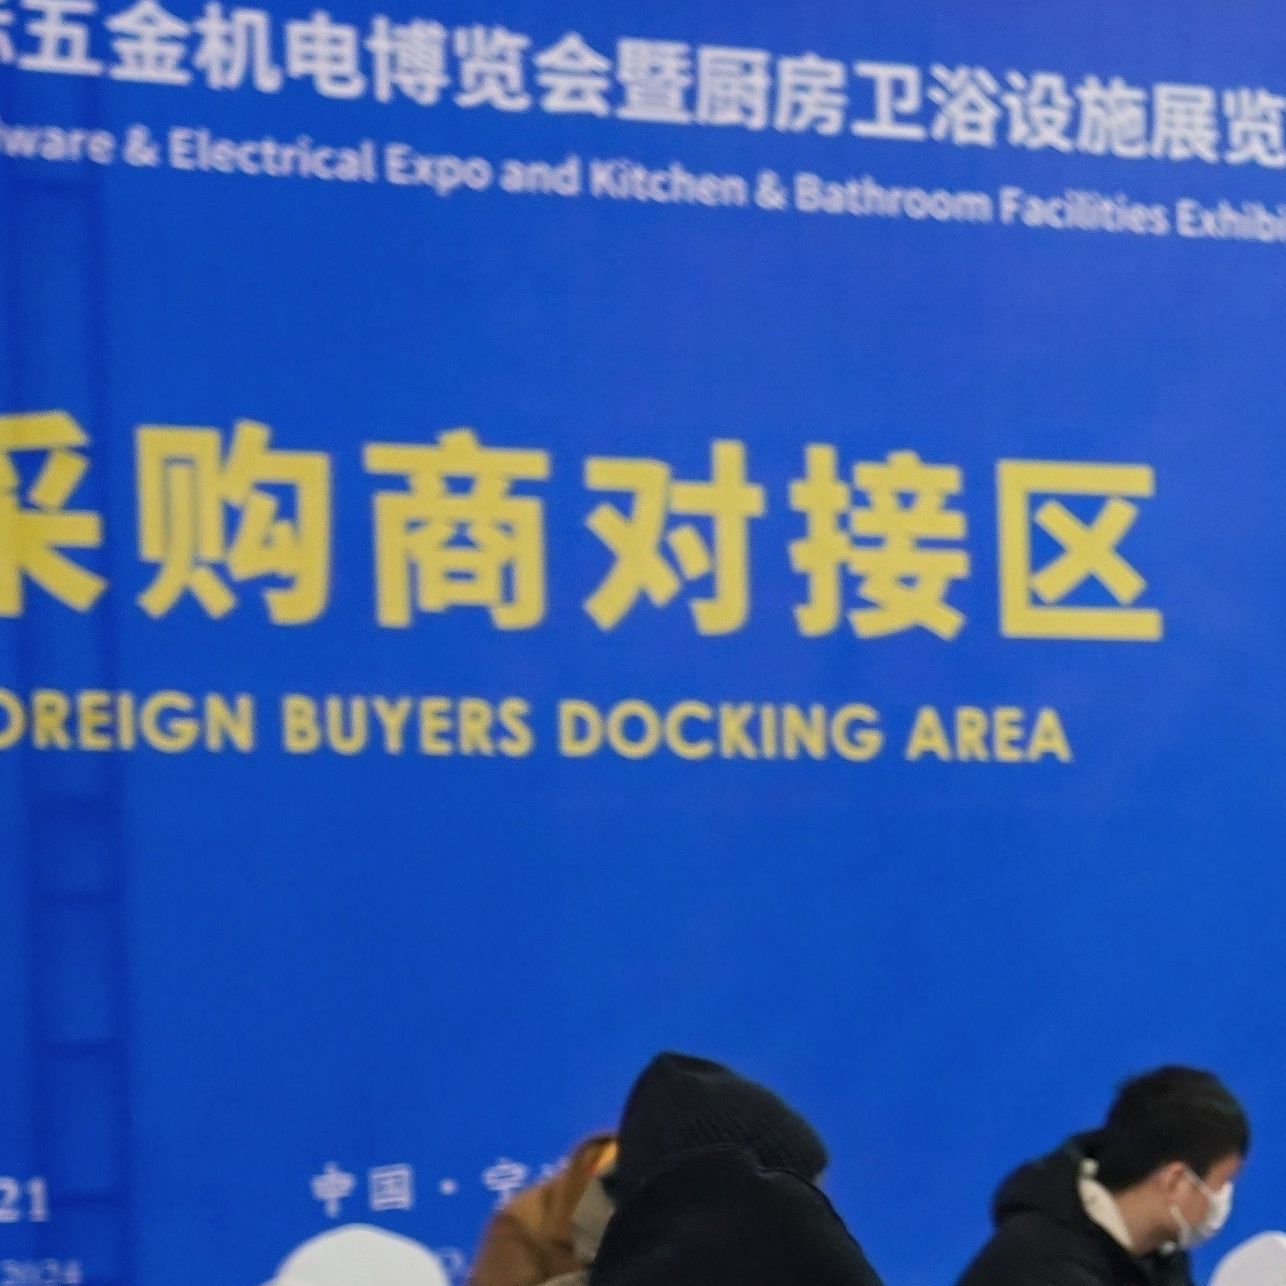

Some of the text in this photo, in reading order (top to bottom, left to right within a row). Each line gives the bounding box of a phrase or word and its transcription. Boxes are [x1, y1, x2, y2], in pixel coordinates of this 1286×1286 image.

[0, 122, 117, 165] ware
[124, 125, 160, 167] &
[169, 127, 376, 182] Electrical
[385, 144, 493, 196] Expo
[500, 154, 582, 196] and
[589, 160, 749, 207] Kitchen
[753, 169, 788, 211] &
[794, 172, 994, 223] Bathroom
[998, 185, 1172, 237] Facilities
[281, 693, 535, 758] BUYERS
[558, 698, 884, 762] DOCKING
[905, 705, 1073, 763] AREA
